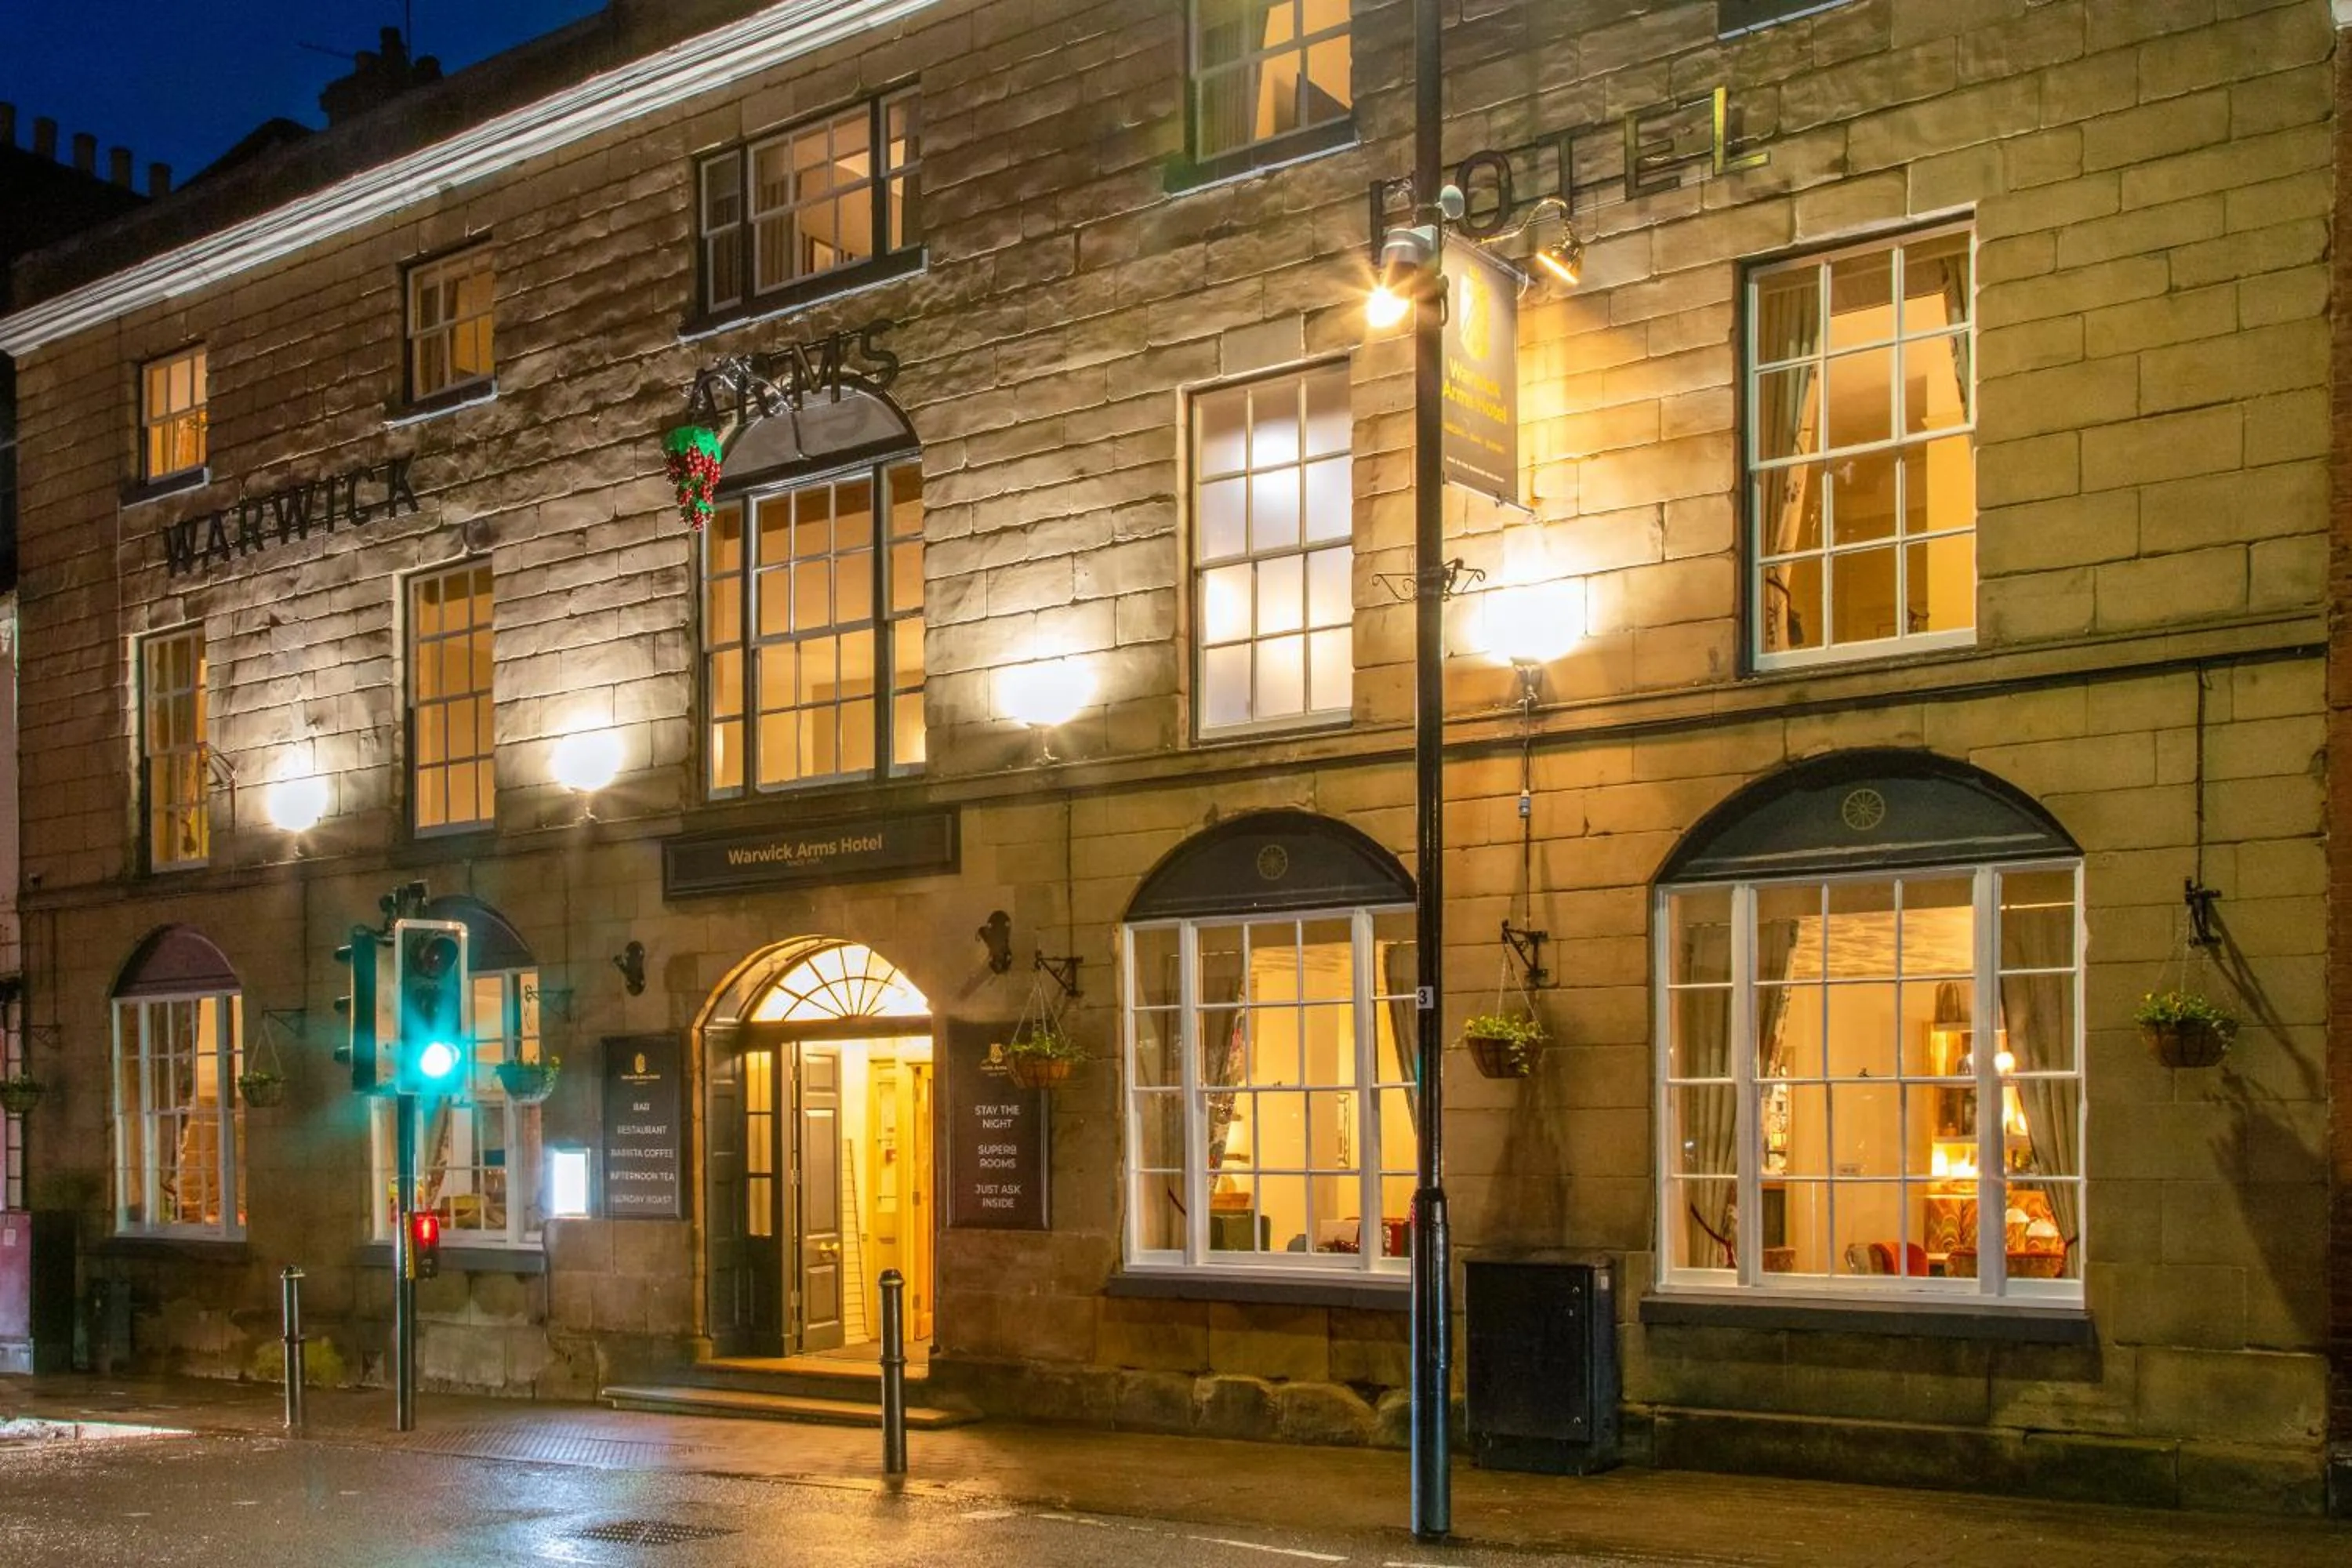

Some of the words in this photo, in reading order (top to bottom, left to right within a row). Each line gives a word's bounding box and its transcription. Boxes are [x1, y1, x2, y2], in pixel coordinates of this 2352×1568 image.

[687, 318, 899, 428] ARMS
[162, 448, 419, 579] WARWICK
[728, 843, 792, 865] Warwick
[797, 841, 837, 858] Arms
[840, 833, 883, 853] Hotel
[633, 1102, 651, 1111] BAR
[975, 1105, 998, 1115] STAY
[1000, 1105, 1020, 1115] THE
[982, 1119, 1013, 1129] NIGHT
[617, 1125, 668, 1135] RESTAURANT
[644, 1149, 674, 1158] COFFEE
[978, 1145, 1017, 1155] SUPERB
[979, 1158, 1017, 1168] ROOMS
[610, 1171, 658, 1181] AFTERNOON
[660, 1171, 675, 1182] TEA
[975, 1184, 999, 1194] JUST
[1001, 1184, 1022, 1194] ASK
[982, 1198, 1014, 1208] INSIDE
